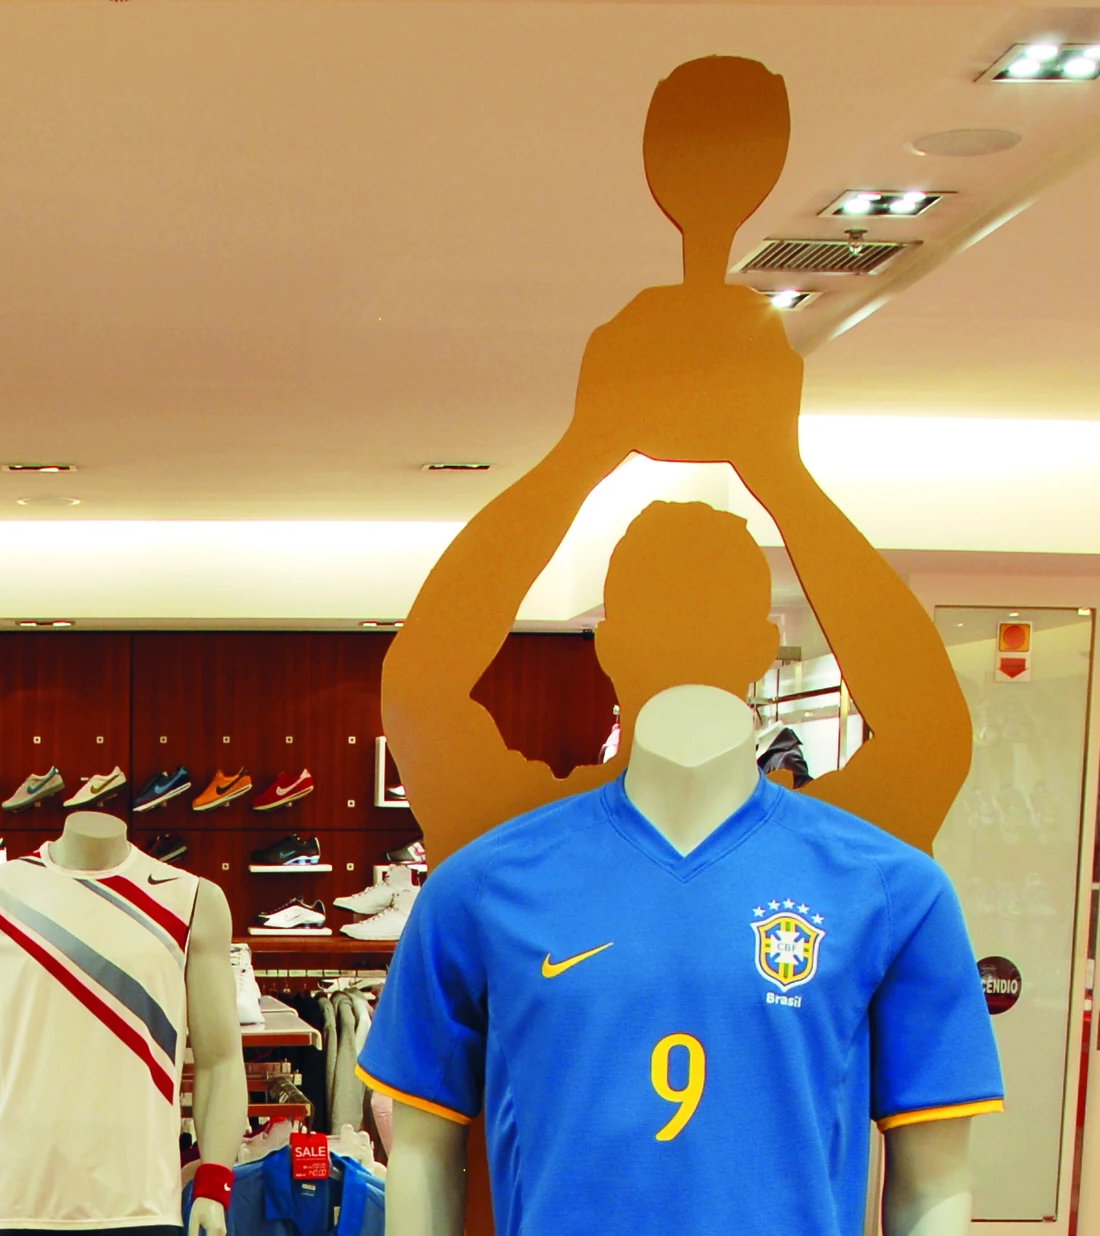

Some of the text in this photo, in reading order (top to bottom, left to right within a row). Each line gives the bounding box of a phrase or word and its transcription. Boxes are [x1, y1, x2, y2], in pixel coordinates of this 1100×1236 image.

[766, 992, 802, 1008] Brasil
[650, 1032, 706, 1141] 9
[295, 1146, 326, 1157] SALE
